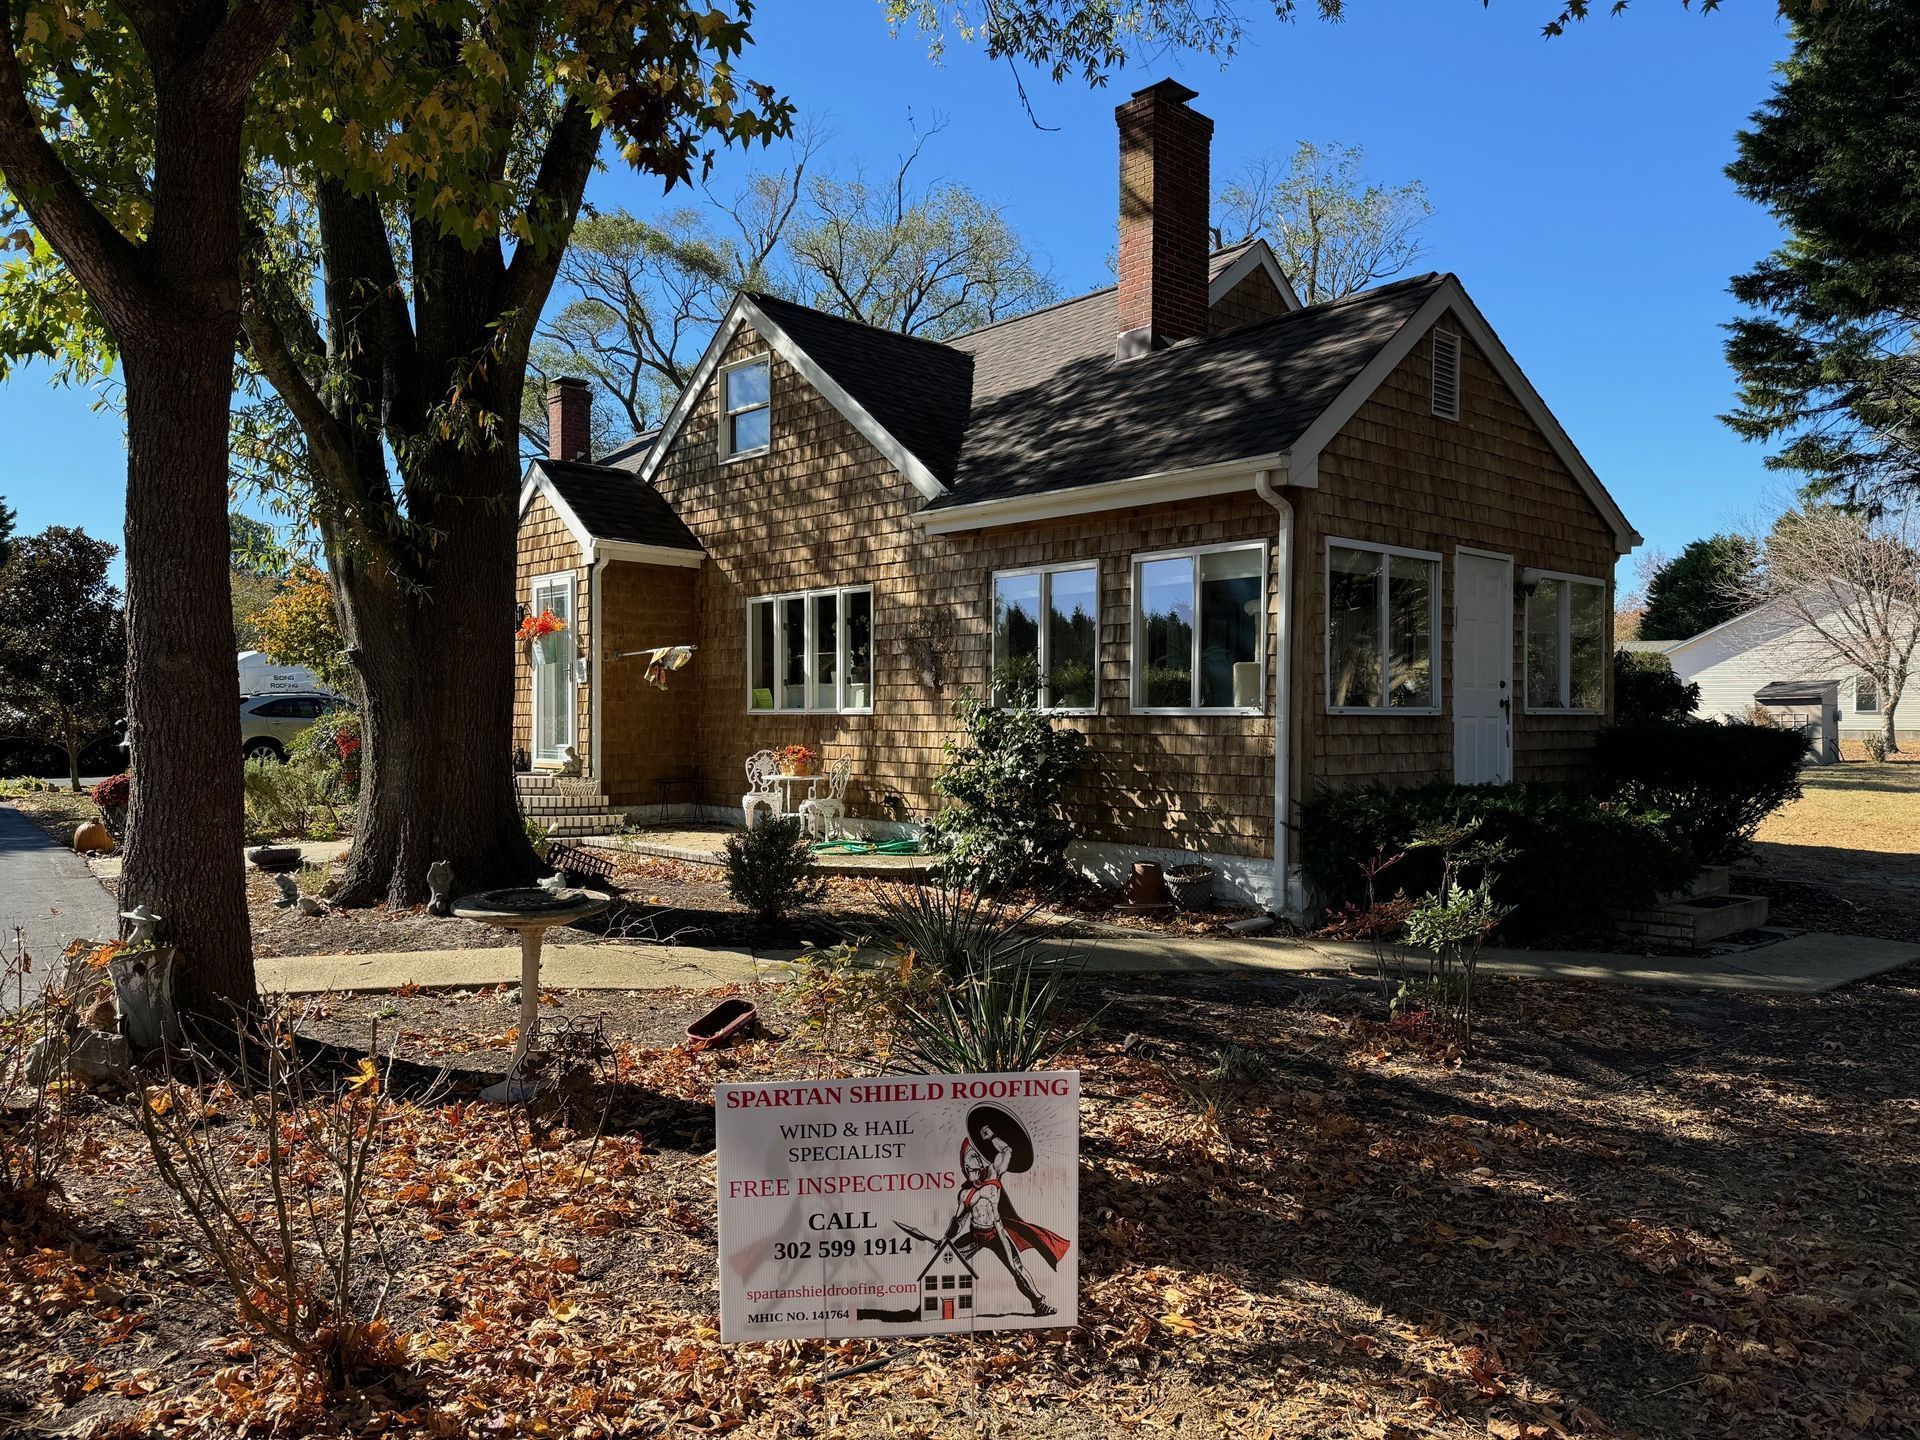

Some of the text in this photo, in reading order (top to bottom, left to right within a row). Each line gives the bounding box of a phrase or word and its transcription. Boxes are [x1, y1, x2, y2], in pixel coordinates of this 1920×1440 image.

[726, 1078, 1070, 1108] SPARTAN SHIELD ROOFING
[779, 1119, 914, 1140] WIND & HAIL
[788, 1143, 906, 1163] SPECIALIST
[728, 1171, 956, 1198] FREE INSPECTIONS
[808, 1211, 878, 1231] CALL
[774, 1237, 912, 1260] 302 599 1914
[746, 1283, 917, 1302] spartanshieldroofing.com
[748, 1309, 850, 1323] MHIC NO. 141764
